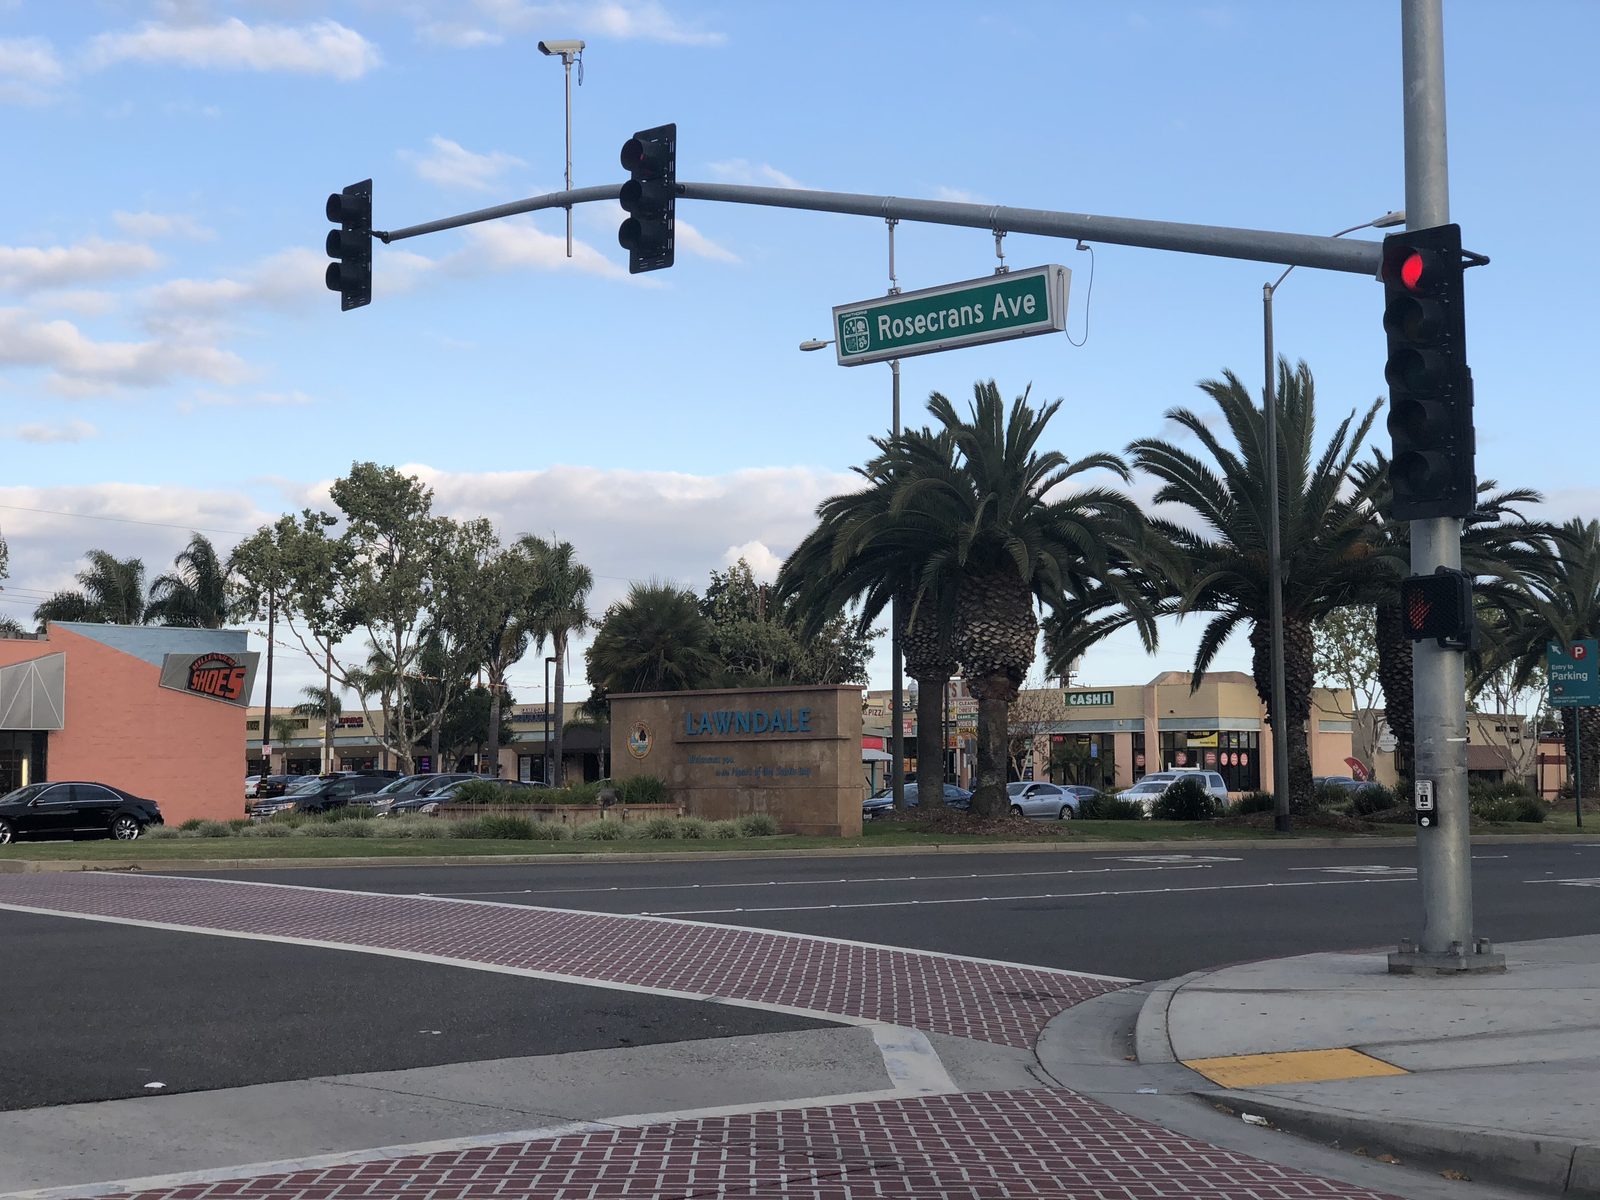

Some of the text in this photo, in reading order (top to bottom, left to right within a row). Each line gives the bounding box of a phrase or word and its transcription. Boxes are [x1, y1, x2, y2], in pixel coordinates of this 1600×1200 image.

[878, 293, 1036, 341] Rosecrans Ave
[1574, 647, 1584, 658] P
[191, 667, 247, 700] SHOES
[1551, 671, 1588, 682] Parking
[686, 707, 814, 736] LAWNDALE
